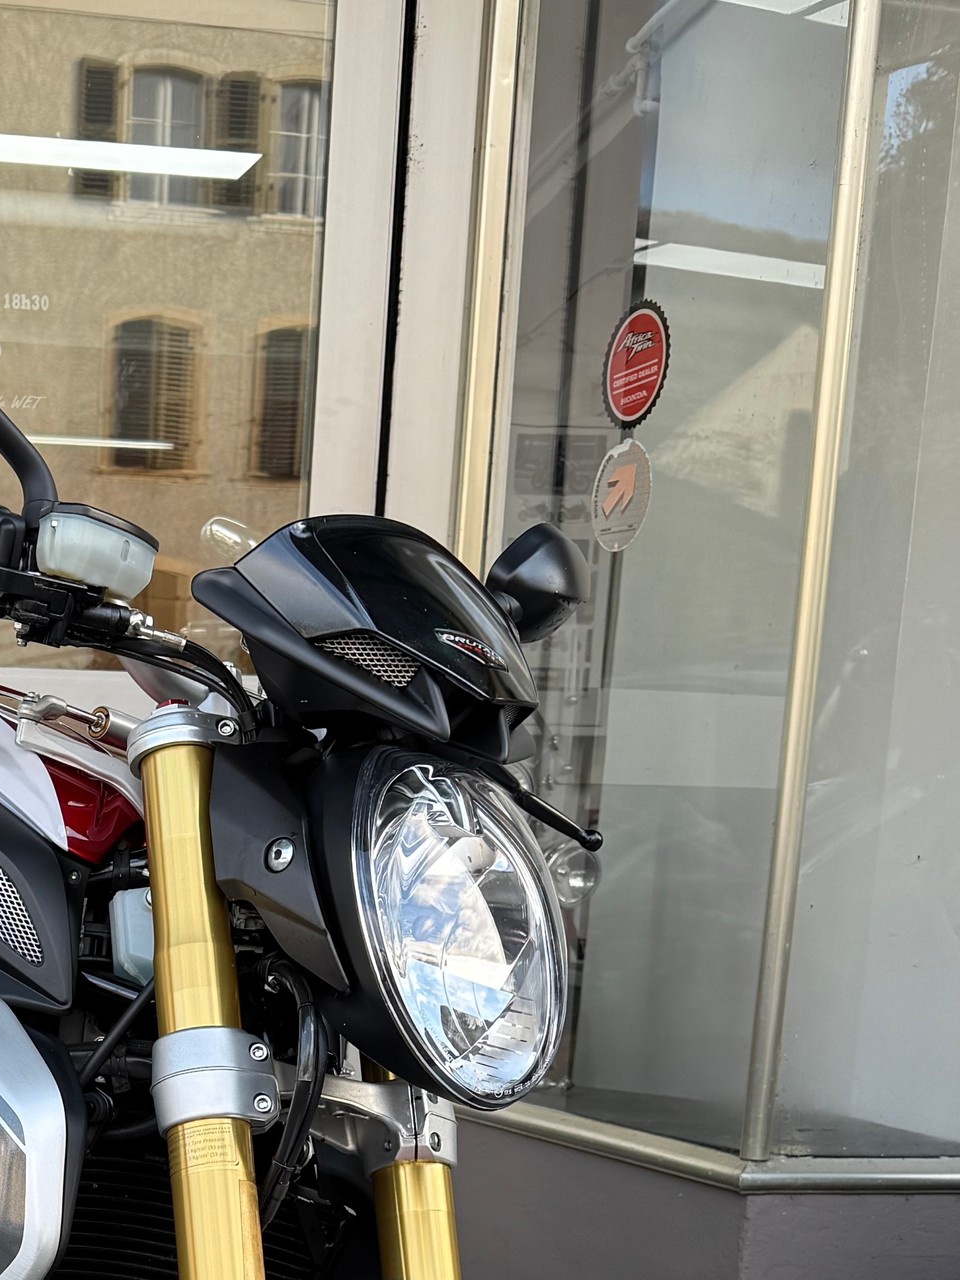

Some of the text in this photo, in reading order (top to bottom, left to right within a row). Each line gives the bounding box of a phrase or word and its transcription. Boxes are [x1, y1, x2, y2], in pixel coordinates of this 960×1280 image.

[3, 293, 49, 311] 18h30
[617, 331, 654, 352] Africa
[628, 340, 656, 360] Twin
[10, 395, 47, 410] WET
[620, 389, 648, 406] HONDA
